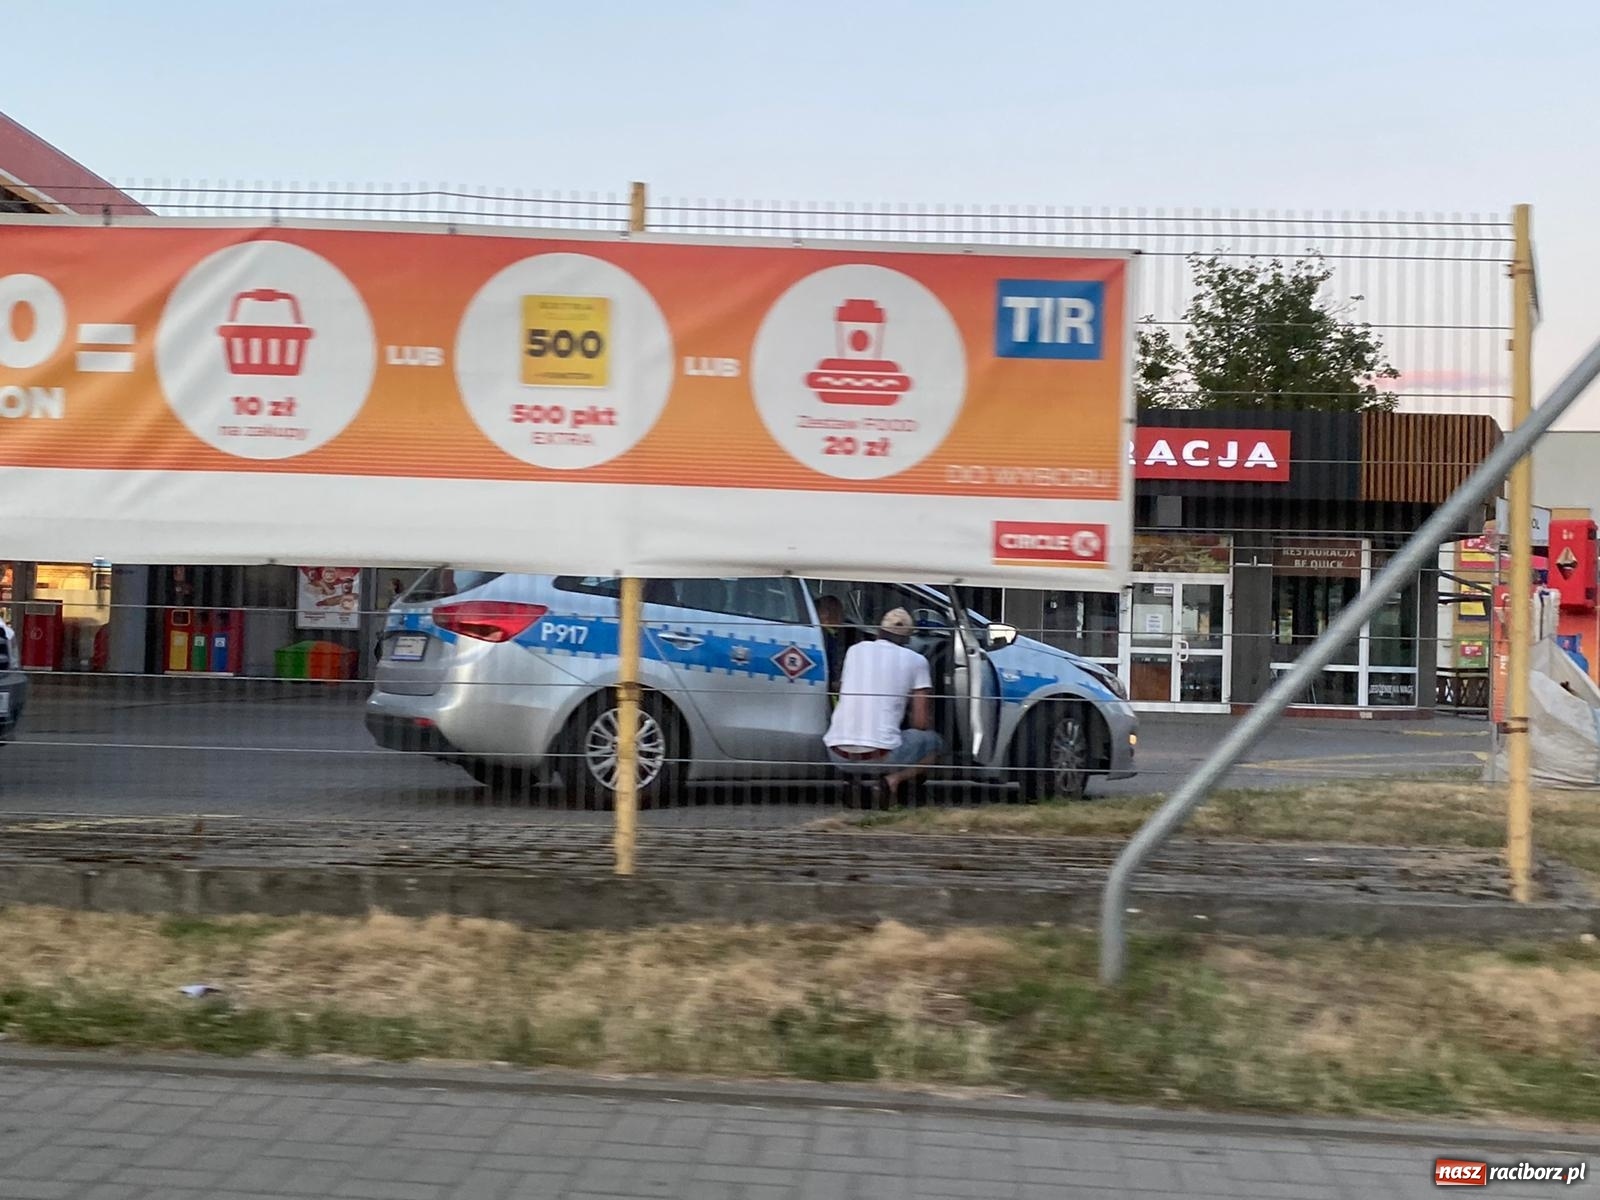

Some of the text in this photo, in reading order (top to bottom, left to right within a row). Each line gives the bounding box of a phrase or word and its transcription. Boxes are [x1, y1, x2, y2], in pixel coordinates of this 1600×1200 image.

[1002, 296, 1095, 344] TIR
[526, 328, 603, 359] 500
[386, 345, 445, 366] LUB
[683, 356, 741, 377] LUB
[230, 397, 296, 416] 10 zł
[510, 404, 617, 428] 500 pkt
[530, 431, 594, 446] EXTRA
[822, 436, 892, 457] 20 zł
[946, 464, 1111, 488] DO WYBORU
[1000, 533, 1070, 550] CIRCLE
[1282, 547, 1357, 558] RESTAURACJA
[1311, 559, 1344, 570] QUICK
[541, 621, 588, 645] P917
